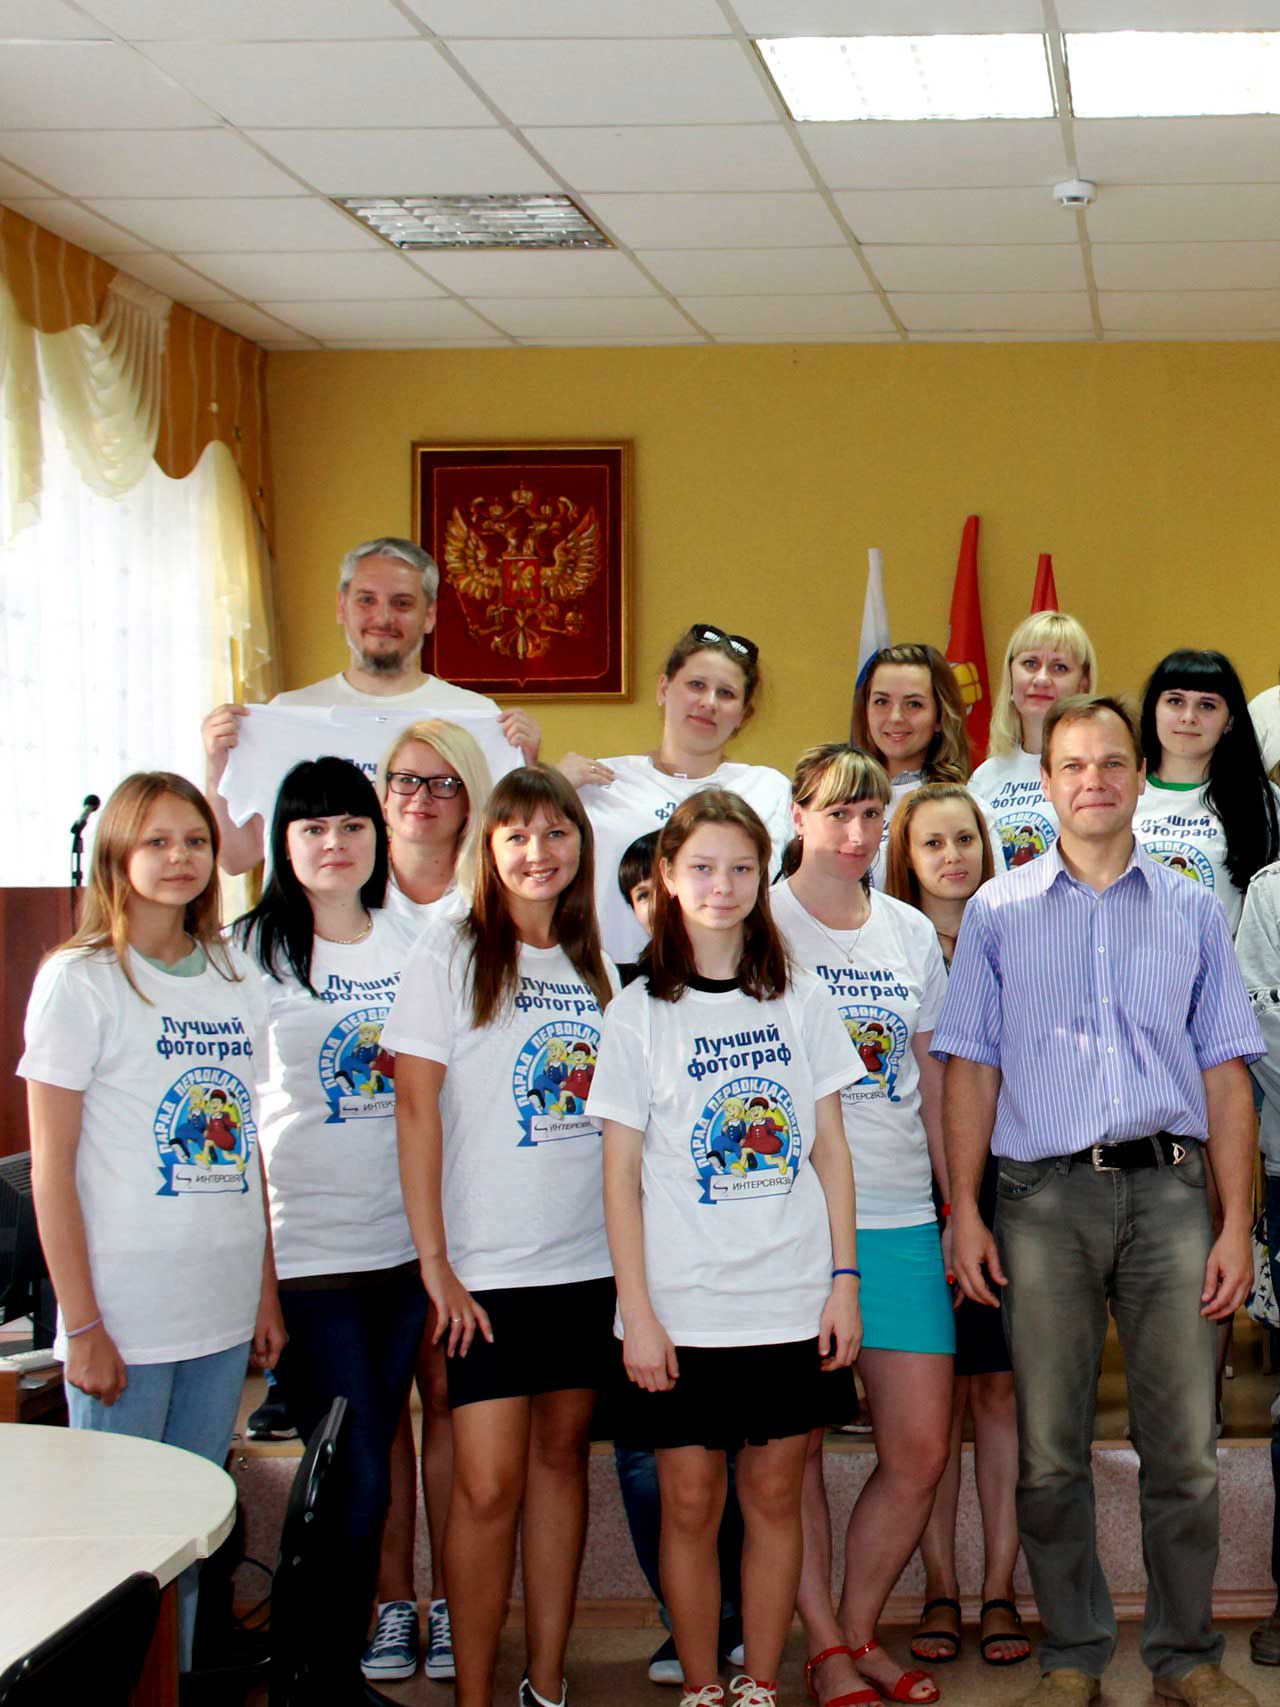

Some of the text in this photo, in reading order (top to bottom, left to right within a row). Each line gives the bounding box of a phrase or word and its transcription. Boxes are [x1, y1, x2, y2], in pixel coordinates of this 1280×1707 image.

[161, 1016, 245, 1039] Лучший
[694, 1023, 781, 1057] Лучший
[687, 1042, 792, 1081] фотограф
